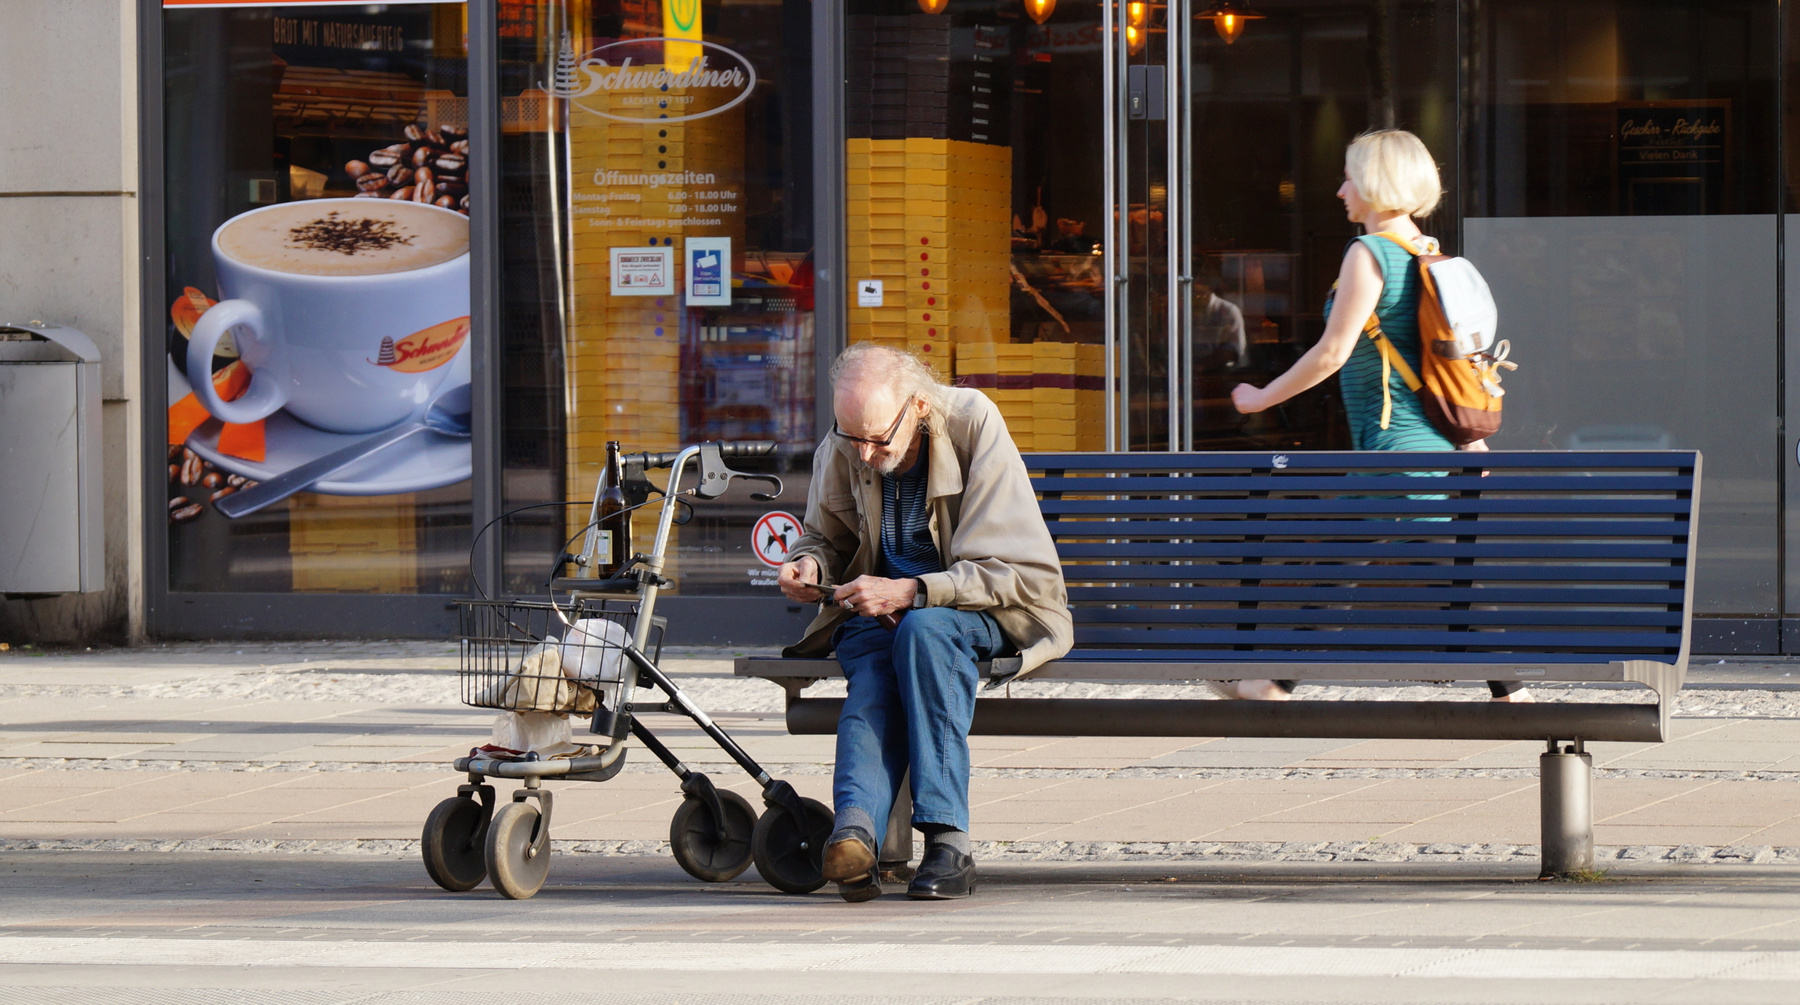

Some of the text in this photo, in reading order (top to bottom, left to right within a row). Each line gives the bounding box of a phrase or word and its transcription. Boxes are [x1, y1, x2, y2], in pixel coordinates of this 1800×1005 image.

[274, 16, 298, 44] BROT
[302, 19, 319, 46] MIT
[579, 55, 745, 97] Schwerdtner
[675, 96, 695, 105] 1937
[1639, 150, 1699, 160] Vielen Dank
[593, 169, 715, 188] Öffnungszeiten
[667, 191, 688, 200] 6.00
[694, 191, 718, 200] 18.00
[720, 190, 737, 200] Uhr
[572, 205, 611, 215] Samstag
[667, 204, 688, 213] 7.00
[694, 204, 718, 213] 18.00
[720, 204, 737, 213] Uhr
[589, 217, 721, 228] Sonn- & Feiertags geschlossen
[747, 568, 760, 576] Wir
